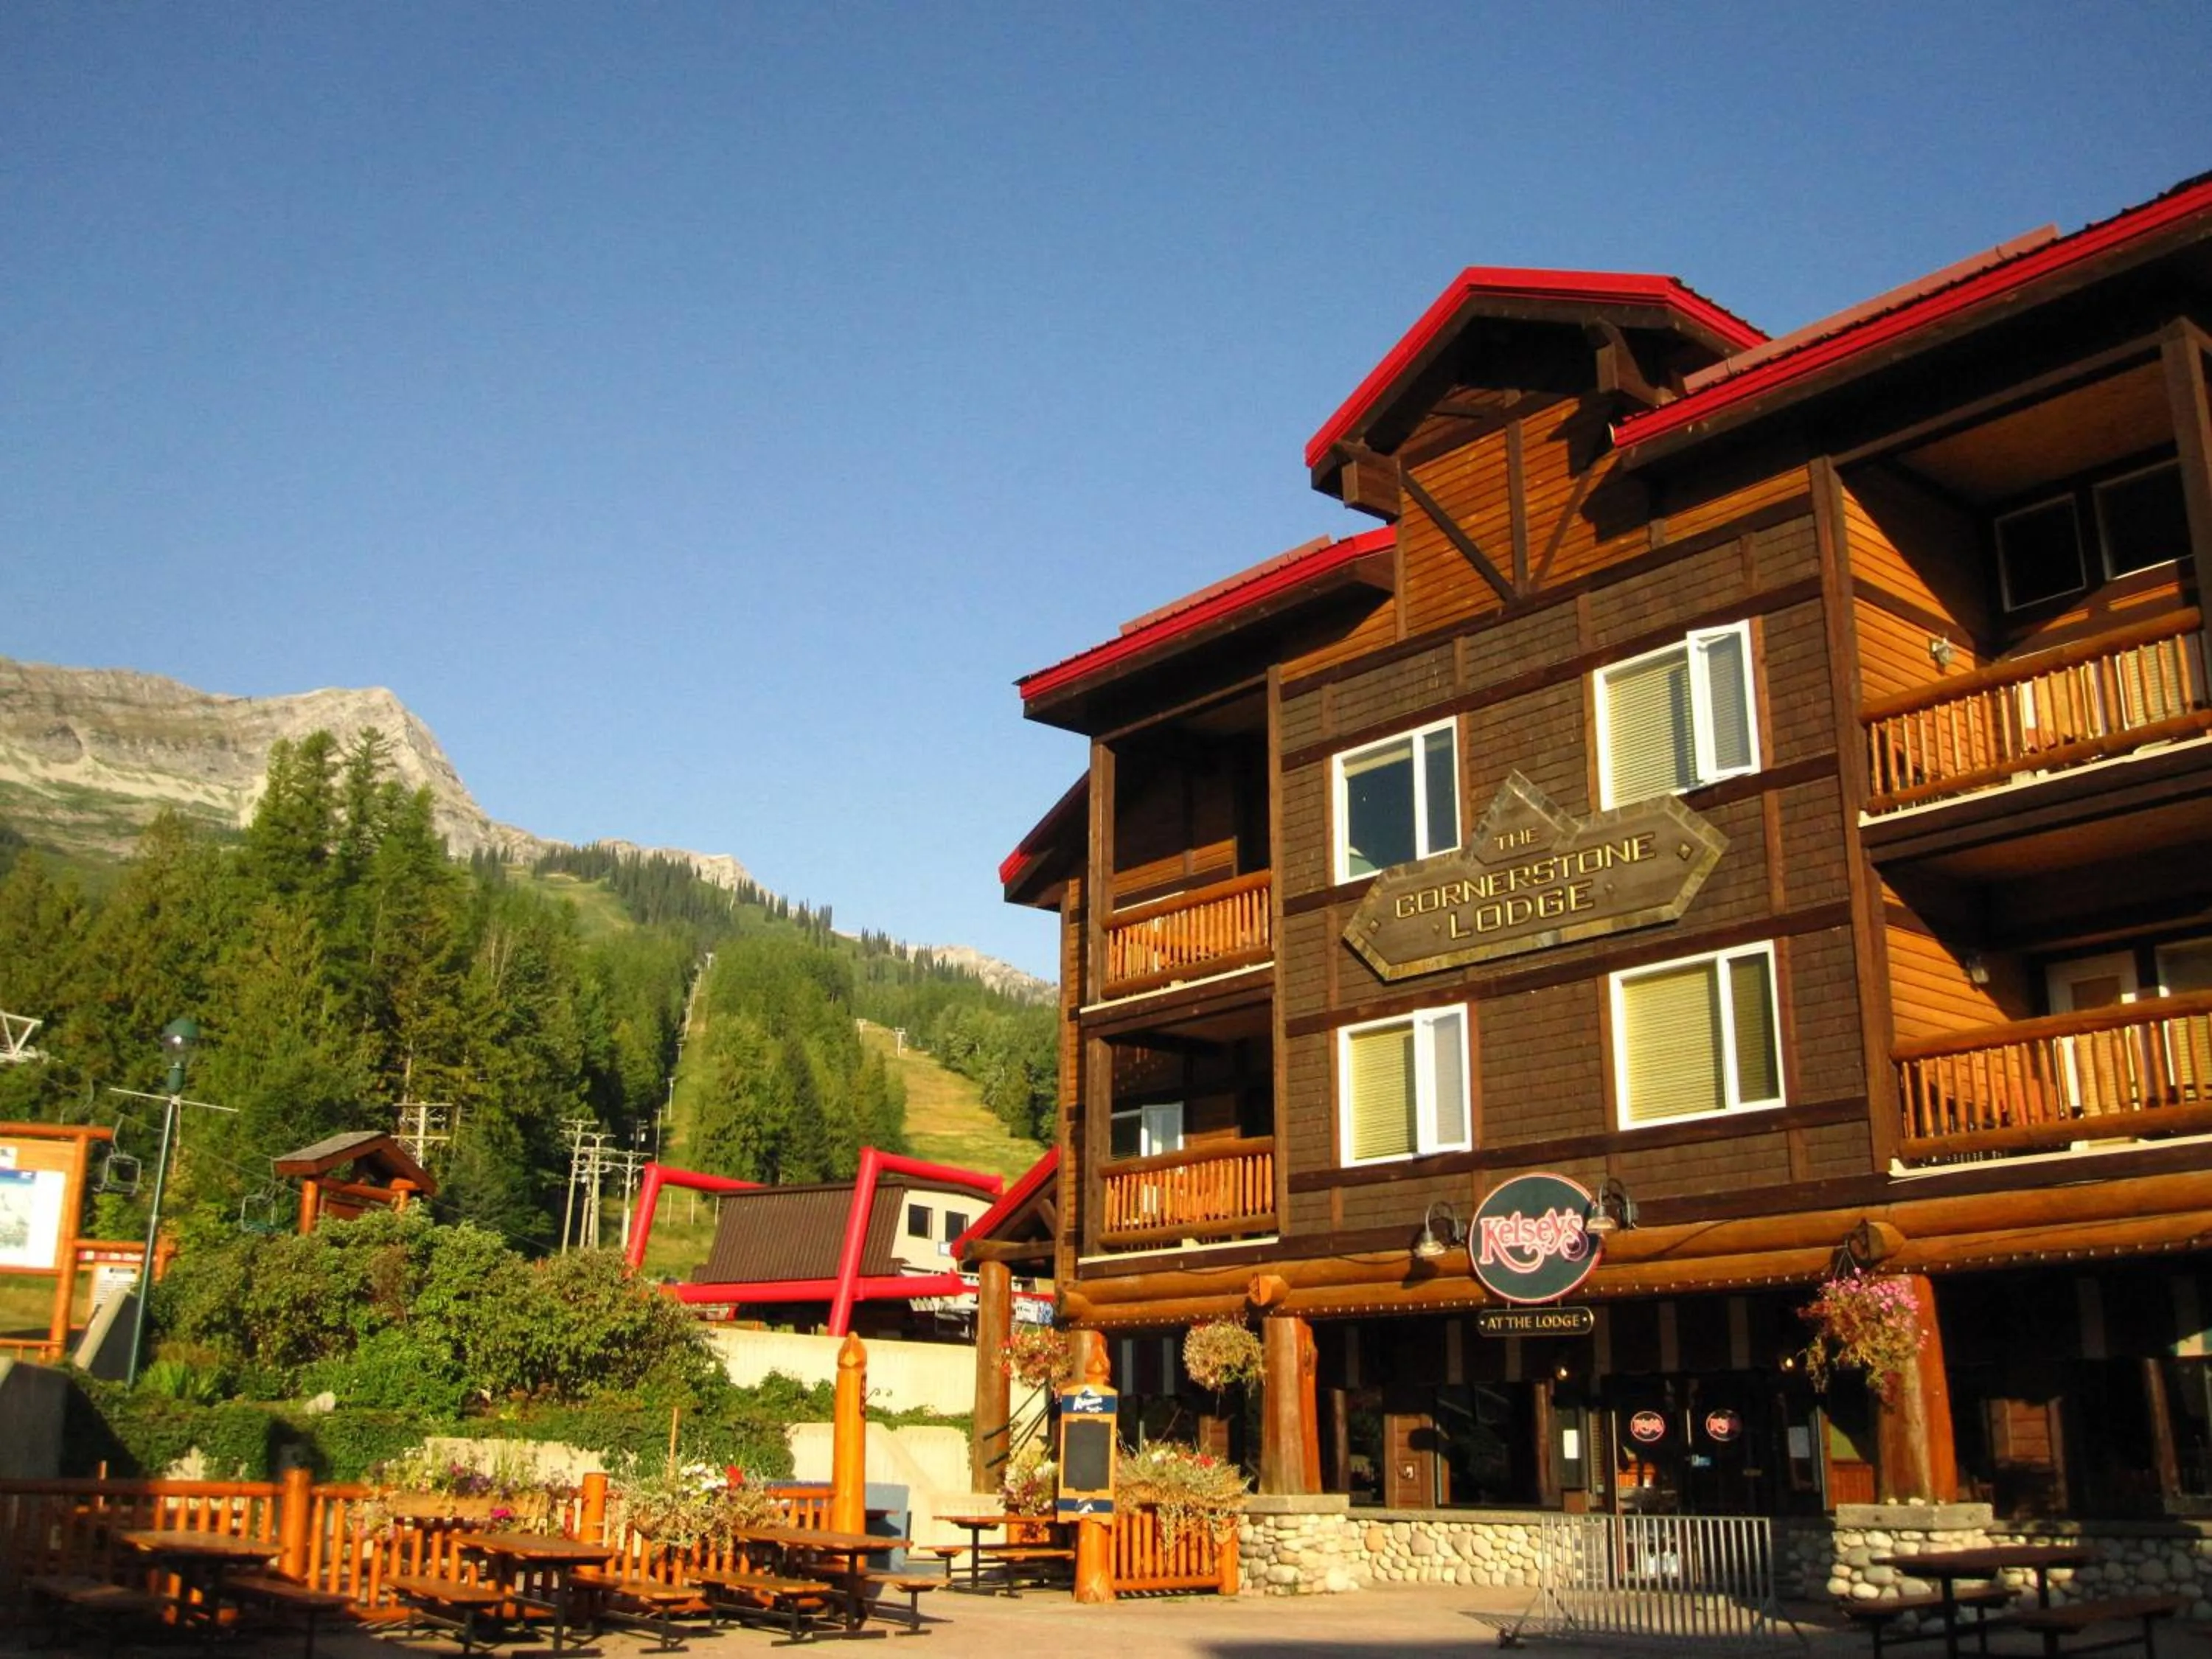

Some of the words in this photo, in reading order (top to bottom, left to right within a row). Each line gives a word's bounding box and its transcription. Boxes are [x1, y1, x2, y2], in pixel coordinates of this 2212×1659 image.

[1494, 828, 1540, 851] THE
[1395, 832, 1656, 919] CORNERSTONE
[1450, 882, 1593, 940] LODGE
[1479, 1208, 1589, 1273] Kelsey's
[1487, 1316, 1504, 1330] AT
[1506, 1315, 1533, 1329] THE
[1536, 1314, 1579, 1328] LODGE
